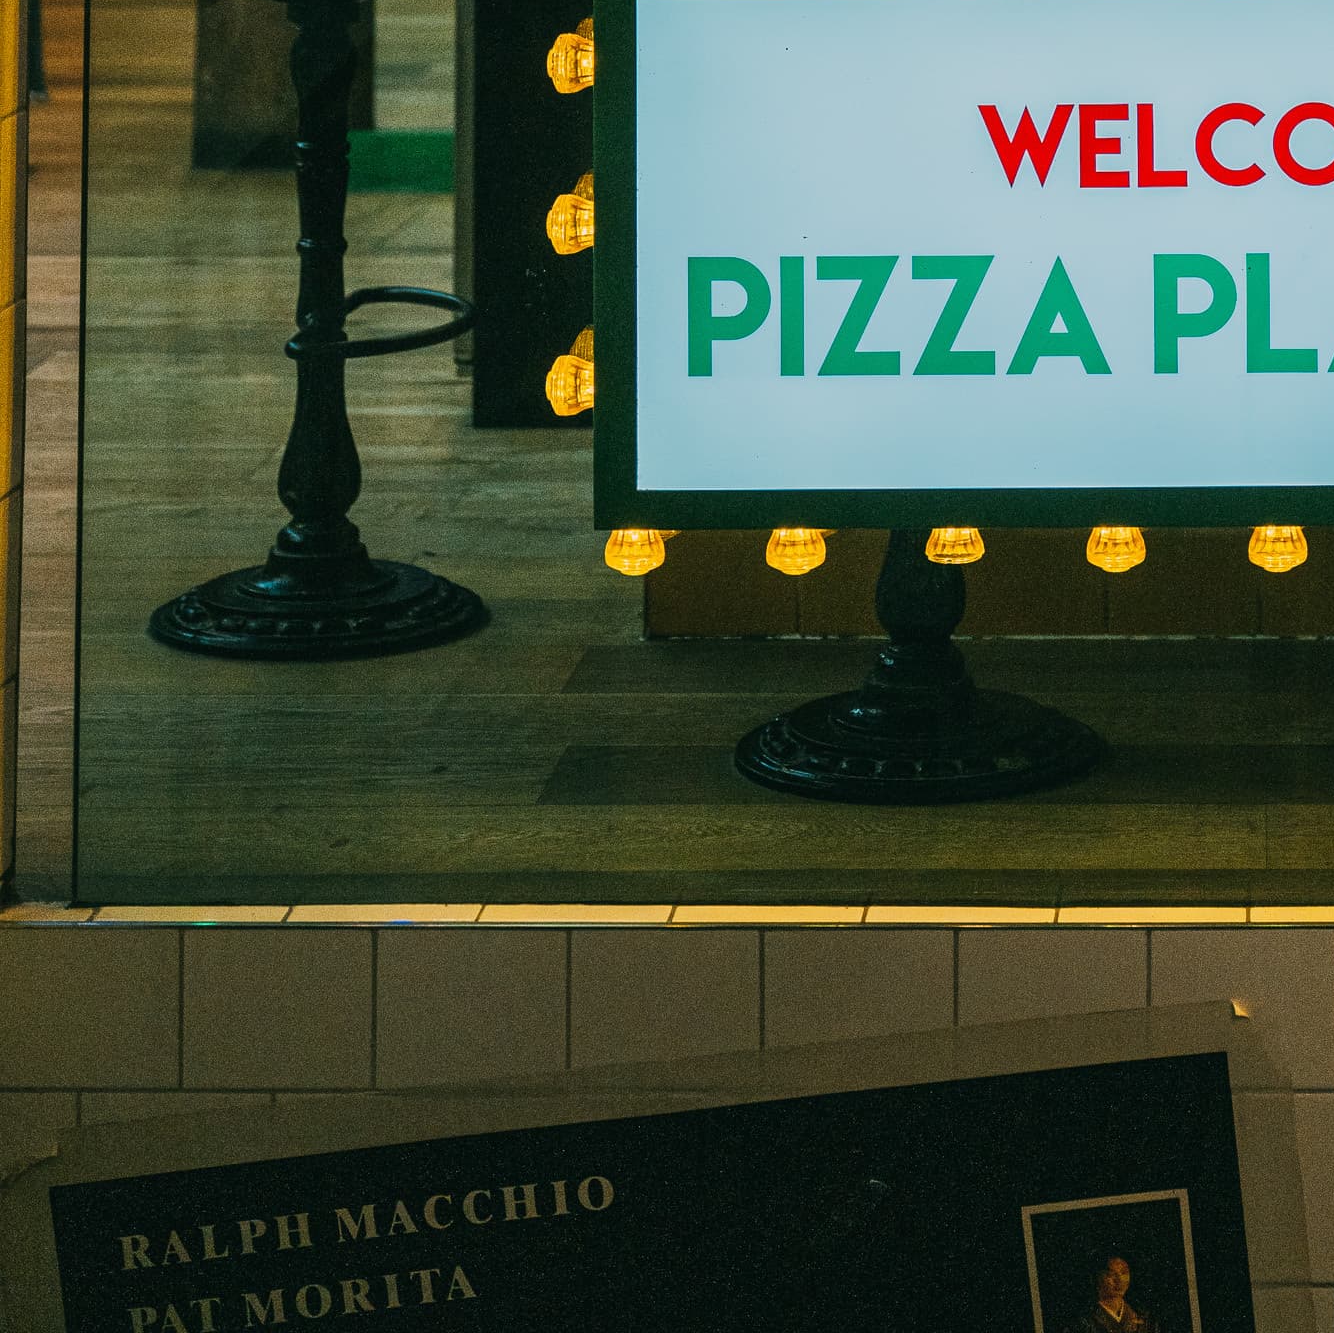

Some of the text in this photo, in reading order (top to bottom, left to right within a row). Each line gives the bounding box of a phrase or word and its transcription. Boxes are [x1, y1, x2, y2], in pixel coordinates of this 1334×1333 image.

[688, 255, 1112, 378] PIZZA
[118, 1175, 615, 1272] RALPH MACCHIO
[126, 1263, 478, 1333] PAT MORITA
